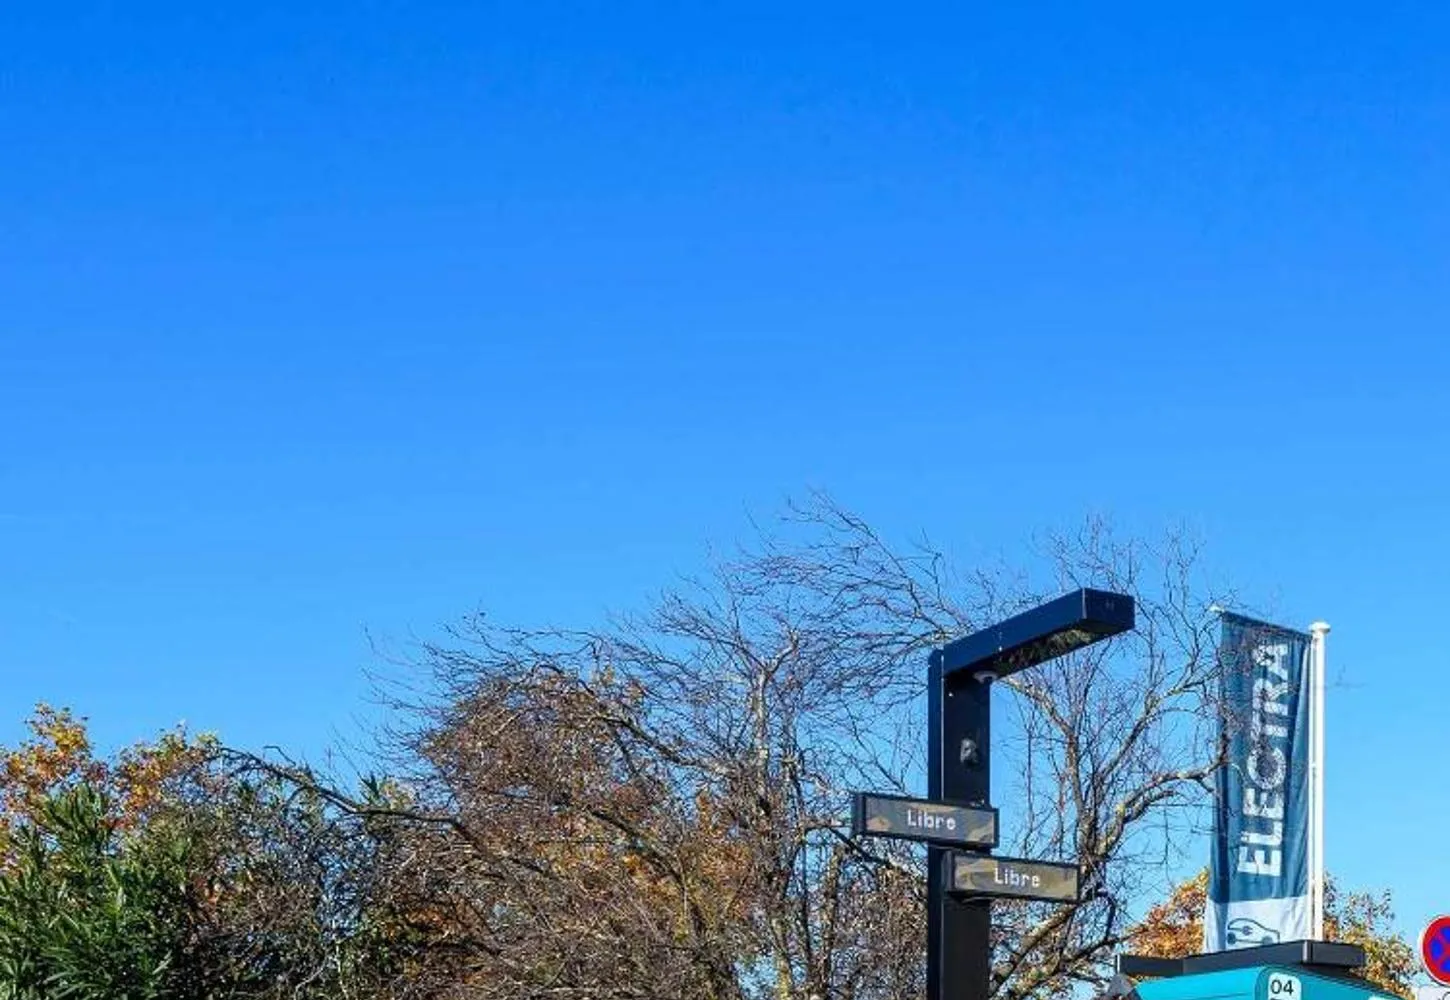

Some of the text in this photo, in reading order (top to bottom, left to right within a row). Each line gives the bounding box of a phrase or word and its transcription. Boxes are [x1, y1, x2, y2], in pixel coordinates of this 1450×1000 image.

[1237, 643, 1289, 877] ELECTRA
[907, 809, 957, 831] Libre
[994, 868, 1041, 888] Libre
[1270, 979, 1294, 995] 04
